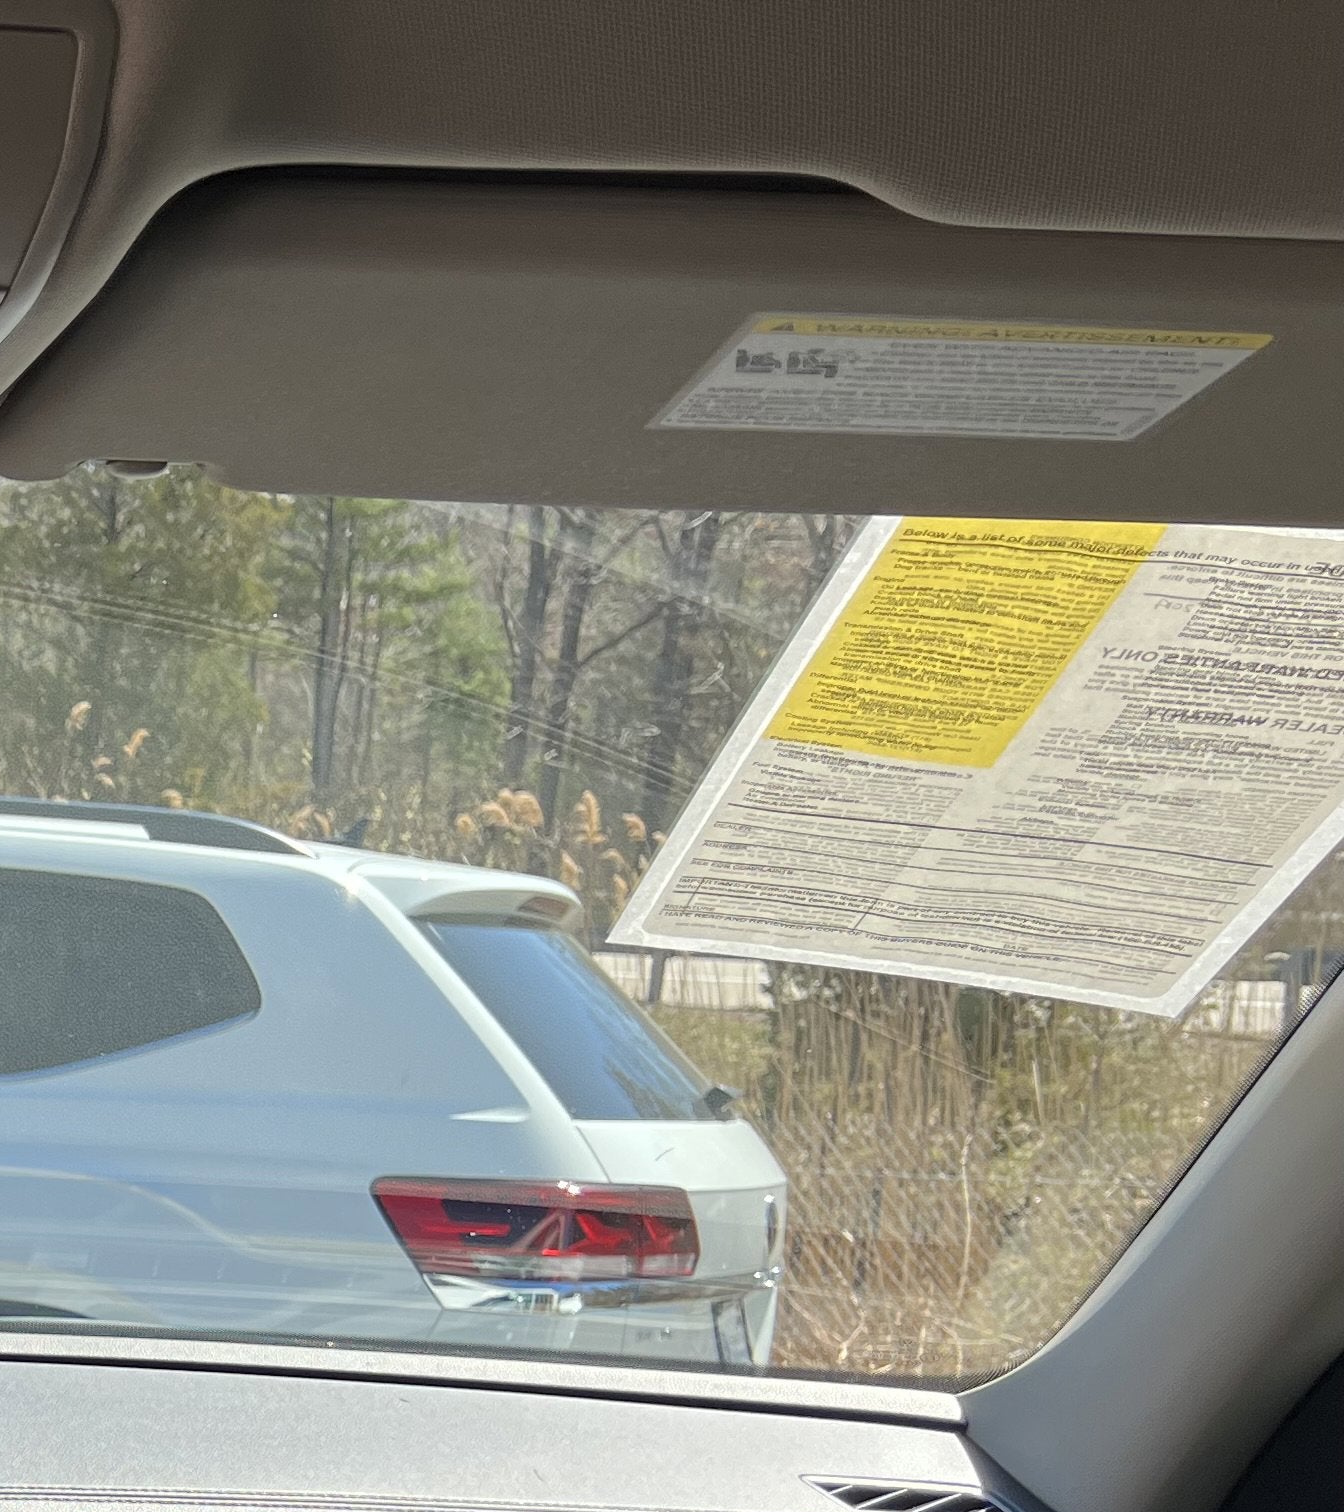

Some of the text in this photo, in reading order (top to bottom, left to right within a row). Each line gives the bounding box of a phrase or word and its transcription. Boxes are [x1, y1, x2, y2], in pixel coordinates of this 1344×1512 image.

[902, 528, 950, 539] Below
[952, 531, 966, 541] is
[981, 532, 1005, 542] list
[1006, 534, 1026, 543] of
[1027, 538, 1067, 548] some
[1173, 550, 1204, 561] that
[1206, 553, 1238, 564] may
[1241, 558, 1283, 570] occur
[1285, 562, 1301, 571] in
